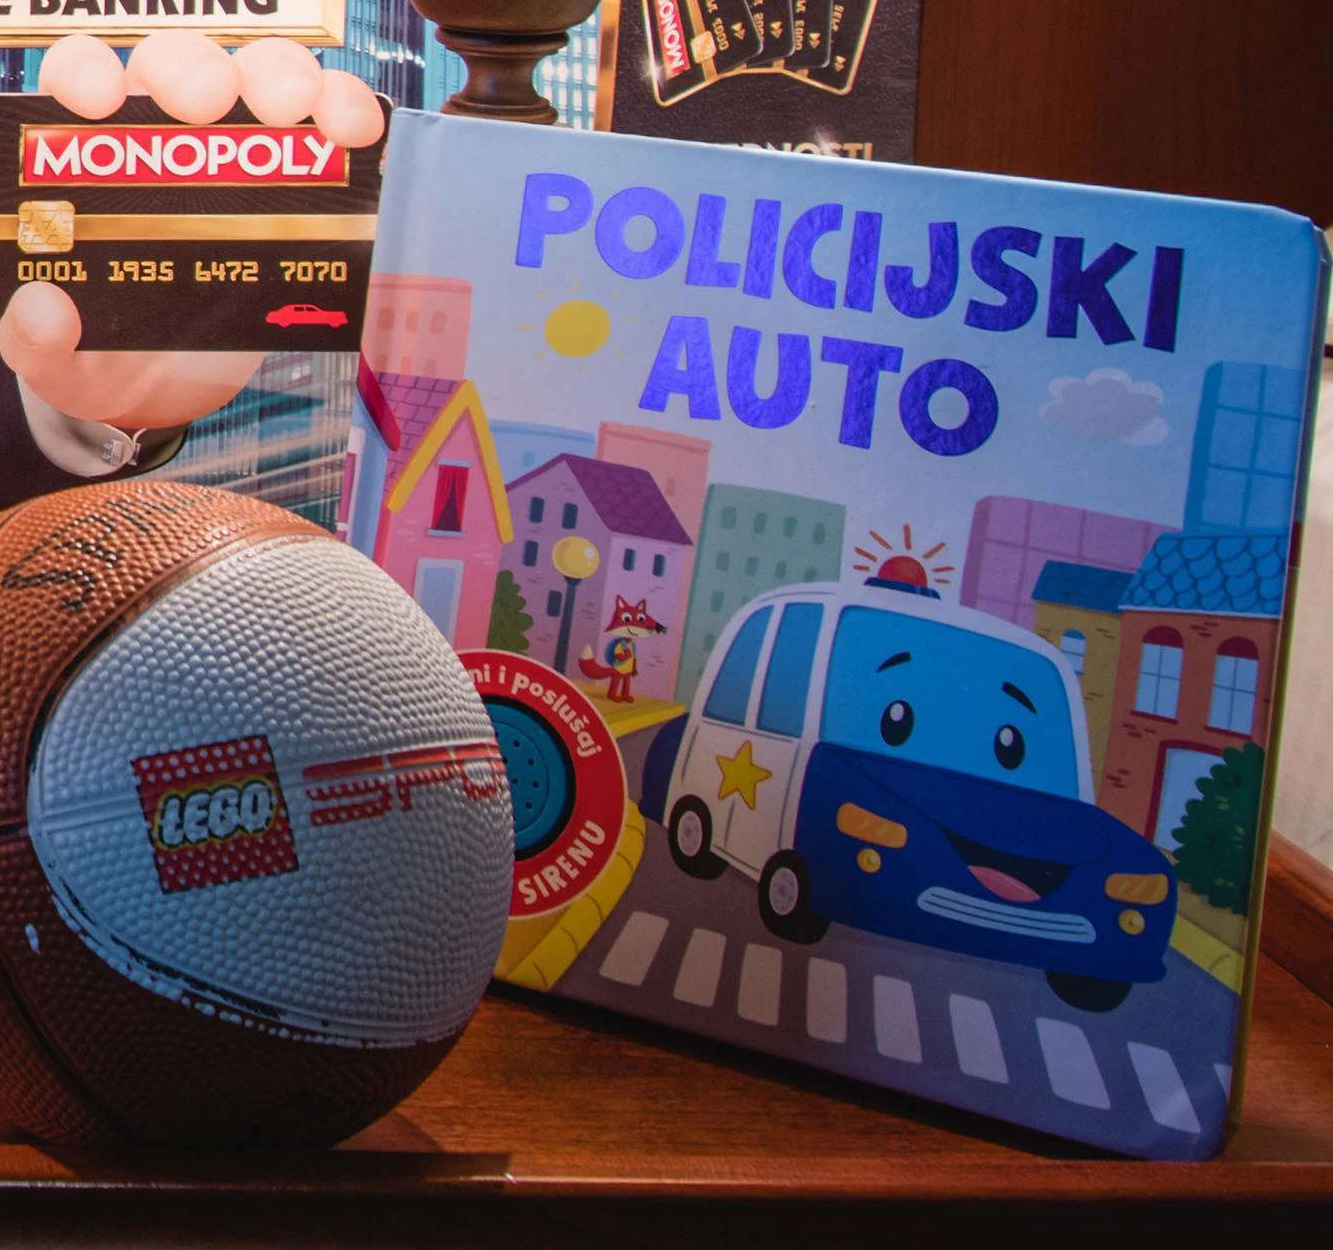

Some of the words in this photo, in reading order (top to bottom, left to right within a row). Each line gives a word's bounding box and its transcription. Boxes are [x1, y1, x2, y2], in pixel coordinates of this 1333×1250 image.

[32, 133, 336, 177] MONOPOLY
[17, 260, 87, 282] 0001
[108, 260, 174, 282] 1935
[195, 260, 259, 282] 6472
[279, 260, 347, 282] 7070
[514, 172, 1185, 353] POLICIJSKI
[638, 315, 999, 457] AUTO
[510, 672, 602, 759] poslušaj
[157, 780, 274, 848] LEGO
[517, 819, 606, 906] SIRENU
